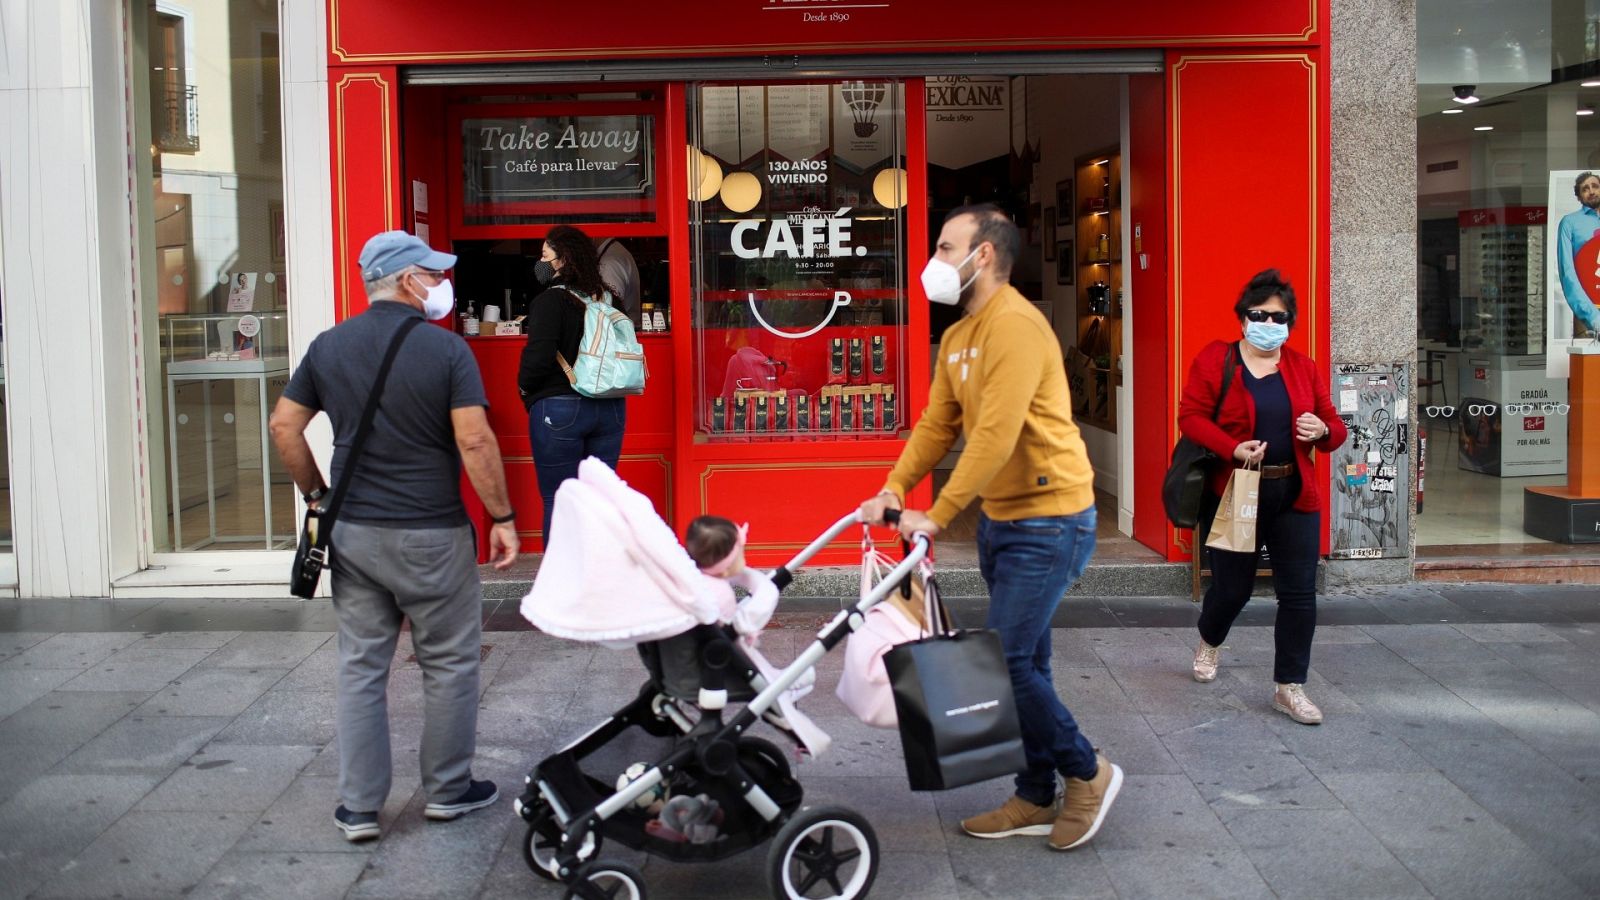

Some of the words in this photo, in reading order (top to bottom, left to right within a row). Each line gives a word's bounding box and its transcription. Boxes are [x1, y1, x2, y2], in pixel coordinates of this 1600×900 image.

[803, 12, 827, 22] Desde
[829, 12, 850, 22] 1890
[936, 113, 956, 122] Desde
[480, 125, 550, 151] Take
[555, 124, 640, 153] Away
[504, 159, 538, 173] Café
[541, 161, 573, 174] para
[576, 159, 618, 172] llevar
[768, 161, 789, 171] 130
[791, 158, 828, 171] AÑOS
[768, 173, 828, 184] VIVIENDO
[1520, 388, 1548, 399] GRADÚA
[1539, 437, 1551, 445] MÁS
[1240, 504, 1257, 518] CAF
